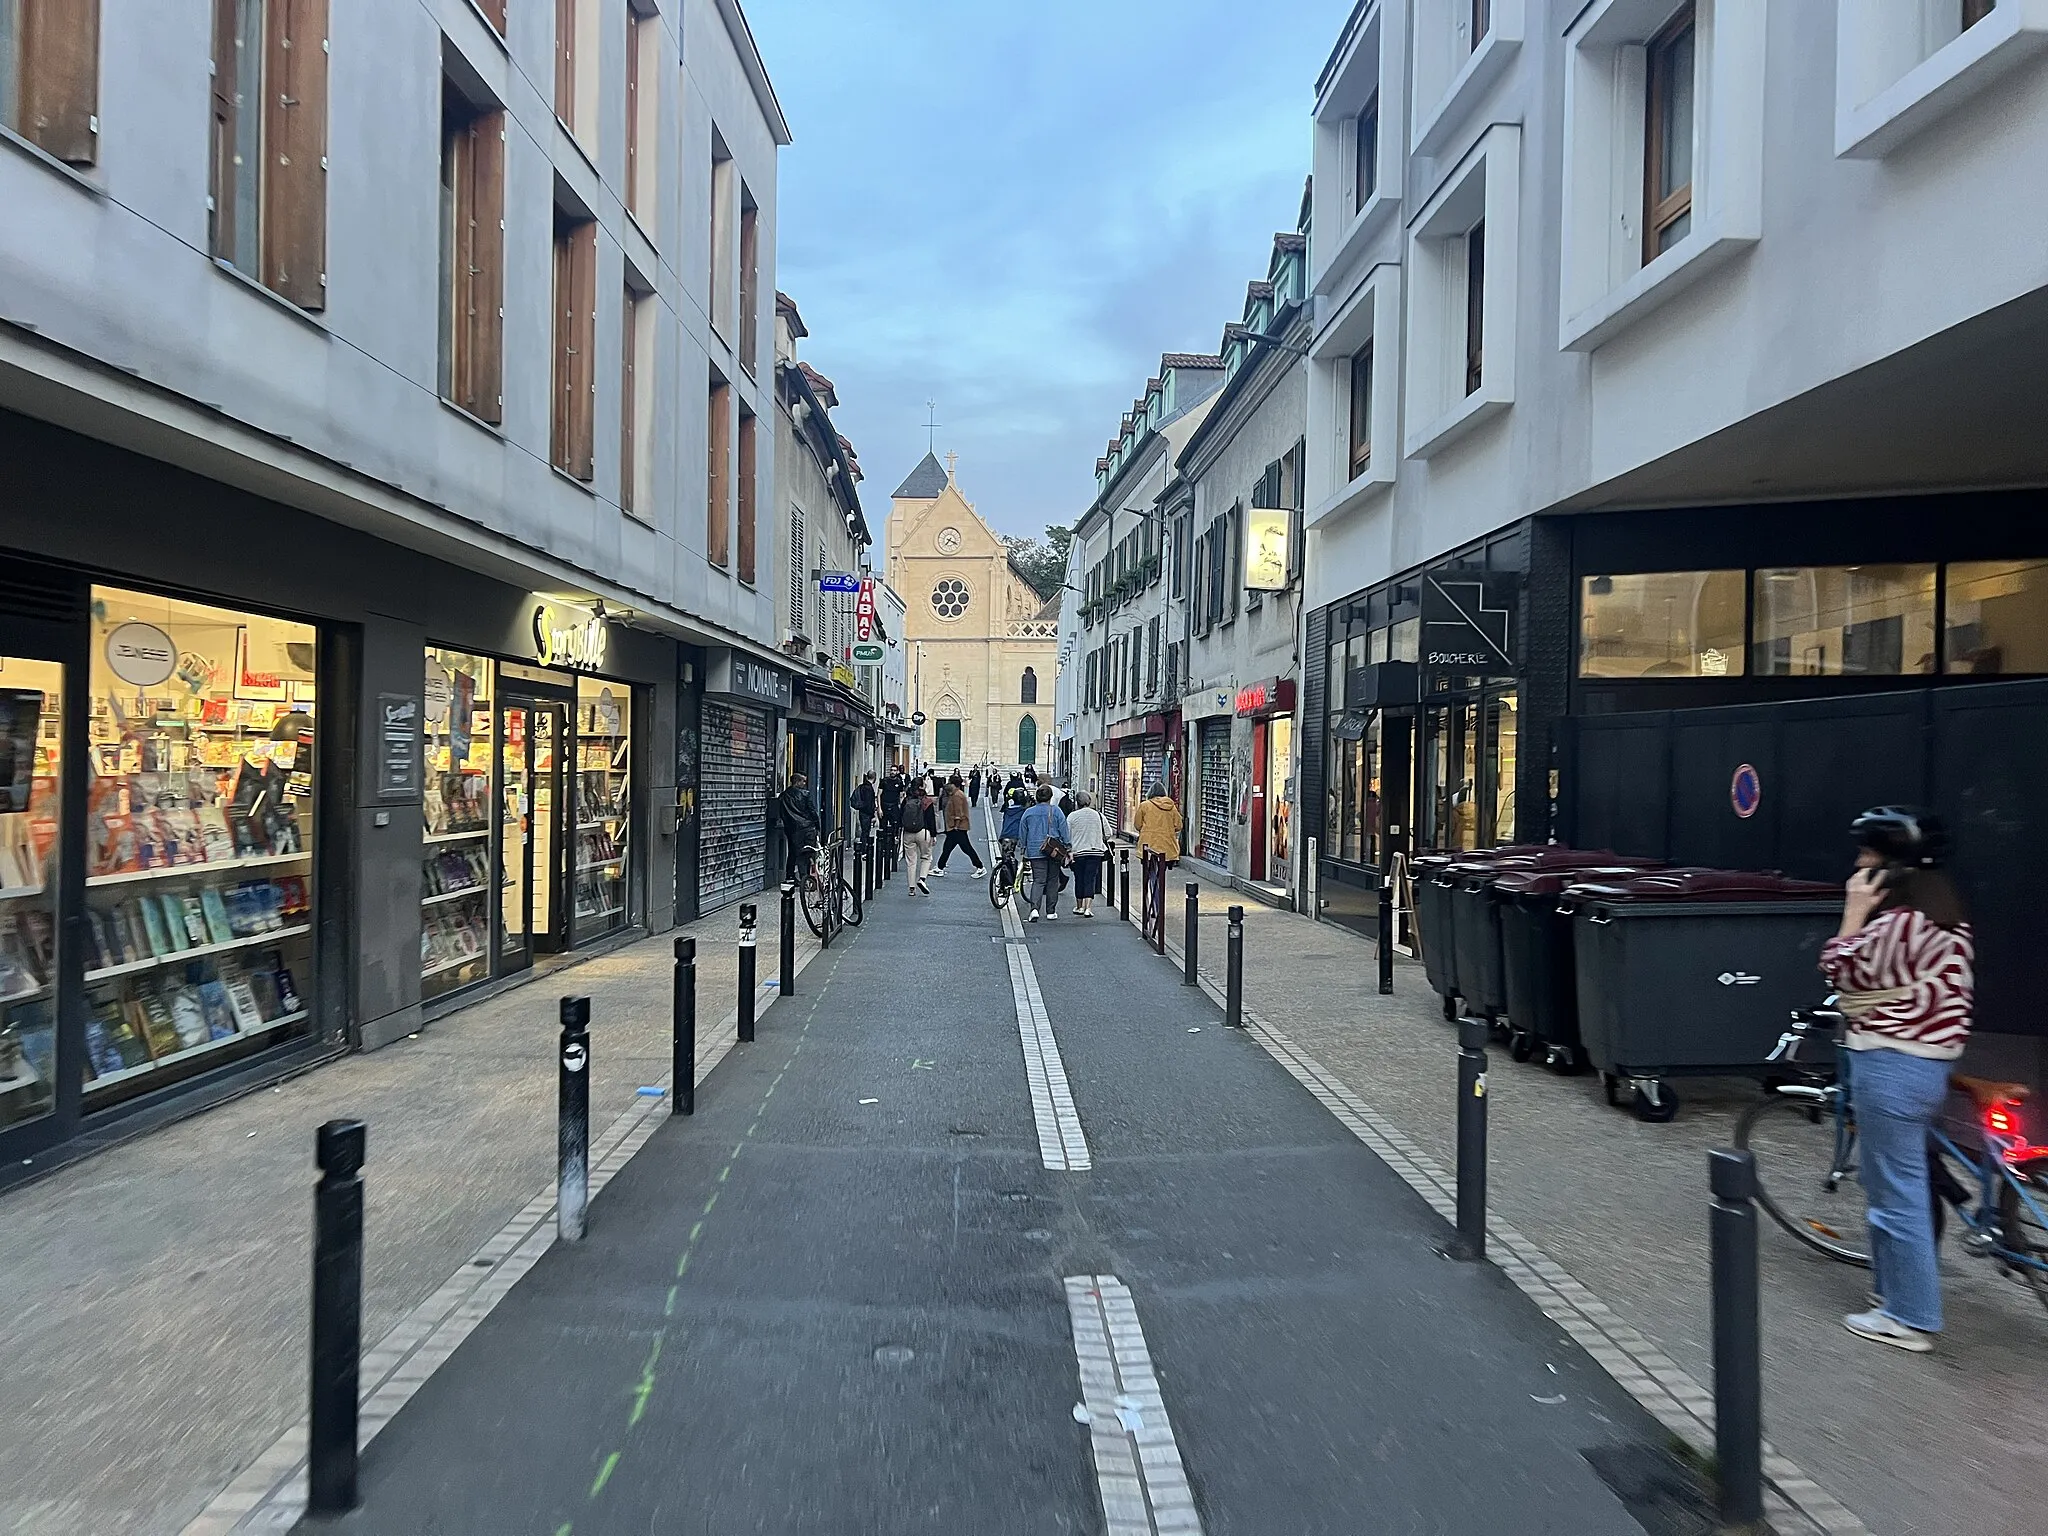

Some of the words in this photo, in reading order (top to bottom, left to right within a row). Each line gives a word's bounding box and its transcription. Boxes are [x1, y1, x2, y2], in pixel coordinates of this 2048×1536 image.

[826, 577, 841, 585] FDJ
[858, 579, 872, 639] TABAC
[1428, 651, 1489, 665] BOUCHERIE
[747, 662, 779, 699] NONANTE
